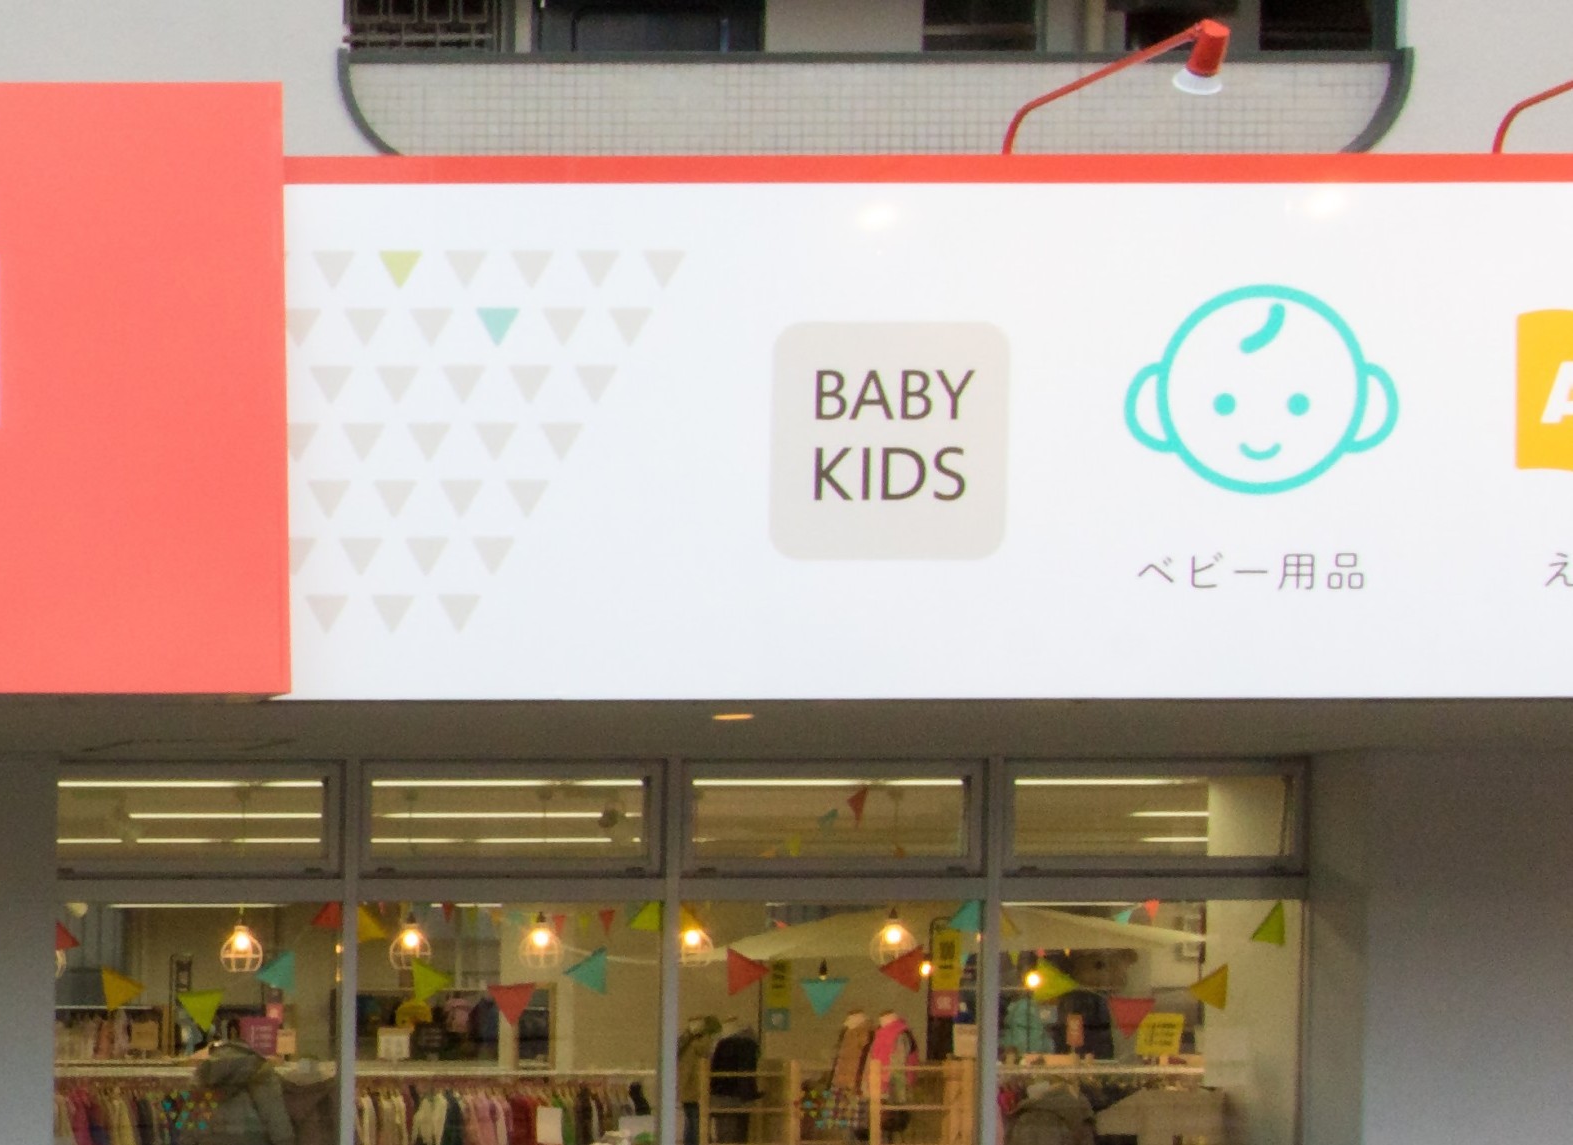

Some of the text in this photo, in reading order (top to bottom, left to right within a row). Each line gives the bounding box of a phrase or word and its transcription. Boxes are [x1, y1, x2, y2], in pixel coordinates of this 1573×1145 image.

[815, 370, 976, 422] BABY
[814, 447, 968, 503] KIDS
[1137, 552, 1366, 592] ベビー用品
